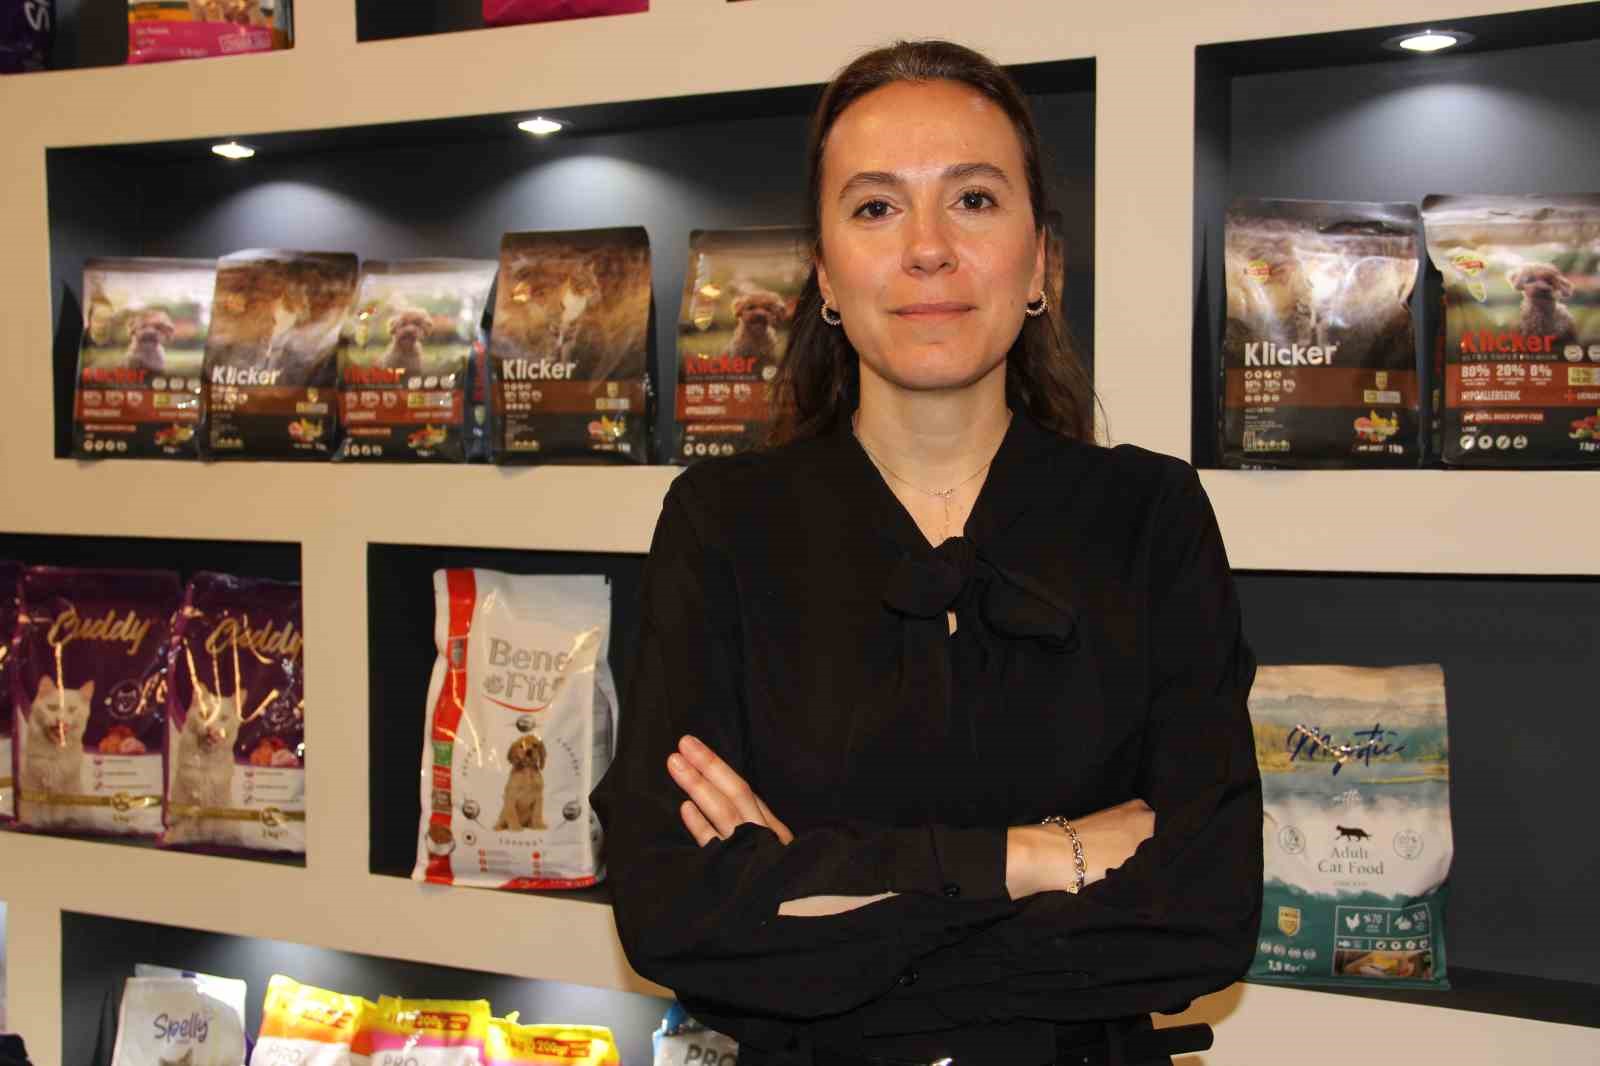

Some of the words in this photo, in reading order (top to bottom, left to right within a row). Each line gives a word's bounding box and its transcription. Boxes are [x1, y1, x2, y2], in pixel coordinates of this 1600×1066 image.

[1244, 341, 1337, 366] Klicker
[212, 365, 281, 385] Klicker
[502, 359, 576, 380] Klicker
[1496, 364, 1525, 377] 20%
[1331, 847, 1369, 860] Adult
[1318, 860, 1343, 874] Cat
[1350, 861, 1384, 876] Food
[153, 1012, 208, 1044] Spelly
[684, 1043, 737, 1066] PRO
